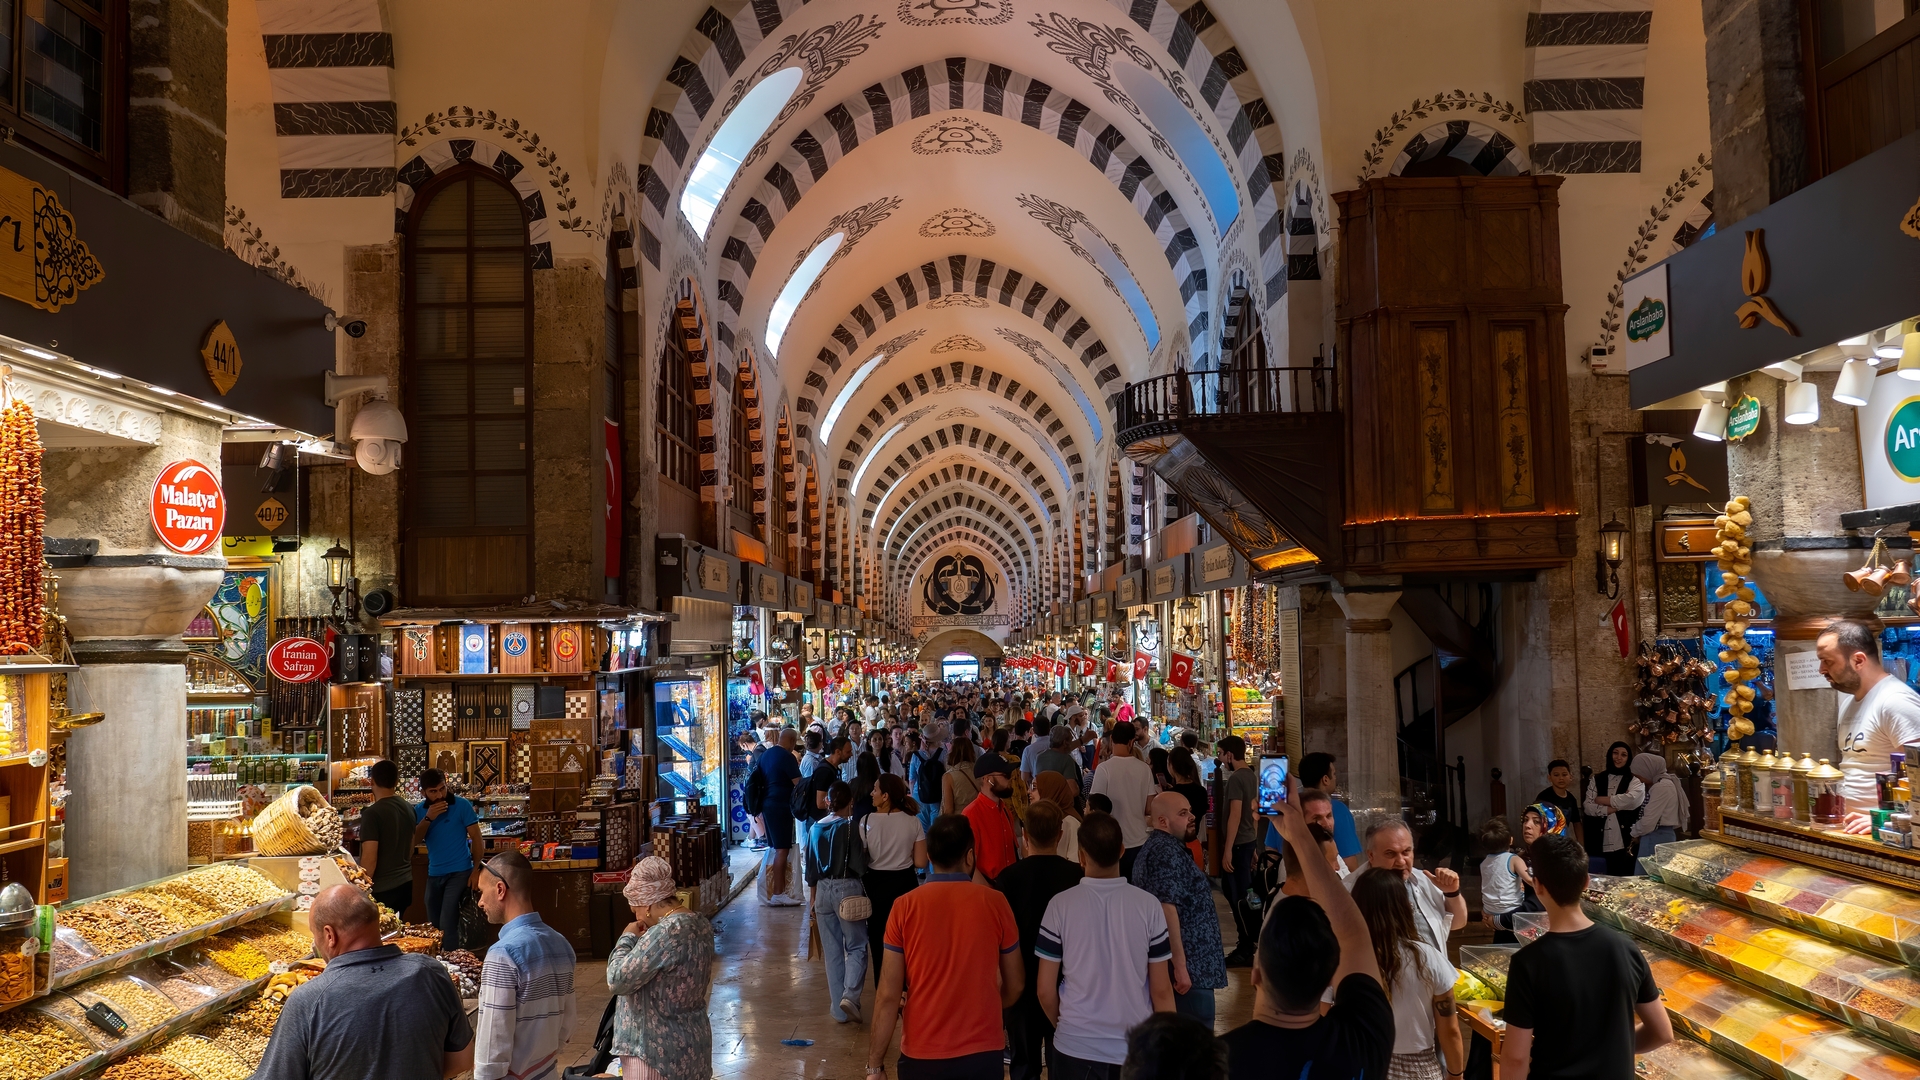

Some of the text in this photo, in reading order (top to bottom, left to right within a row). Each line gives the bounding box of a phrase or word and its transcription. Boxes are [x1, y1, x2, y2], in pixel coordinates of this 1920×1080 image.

[213, 340, 236, 375] 44/1
[1894, 424, 1920, 452] Ar
[165, 508, 213, 531] Pazarı
[257, 507, 284, 522] 40/B
[282, 646, 317, 660] İranian
[283, 660, 315, 672] Safran
